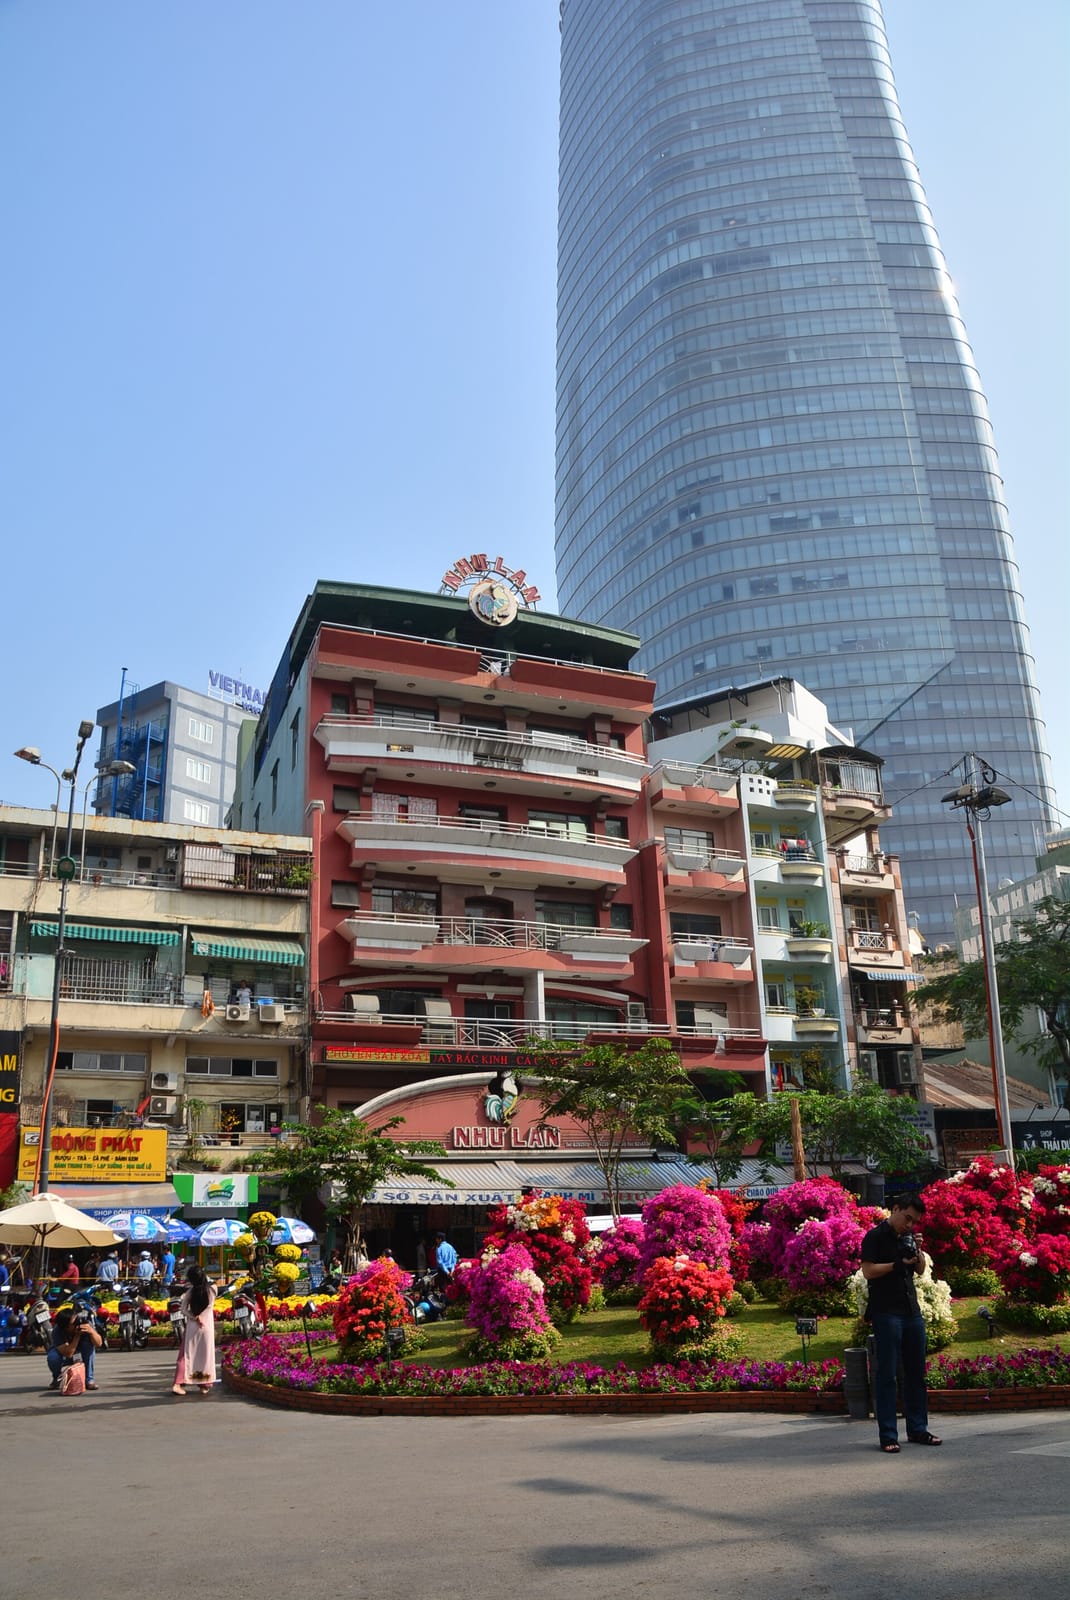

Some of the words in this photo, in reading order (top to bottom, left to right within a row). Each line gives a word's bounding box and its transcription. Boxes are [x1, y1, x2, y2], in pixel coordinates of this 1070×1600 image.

[494, 556, 541, 603] LAN
[482, 1055, 509, 1065] KINH
[511, 1126, 561, 1148] LAN
